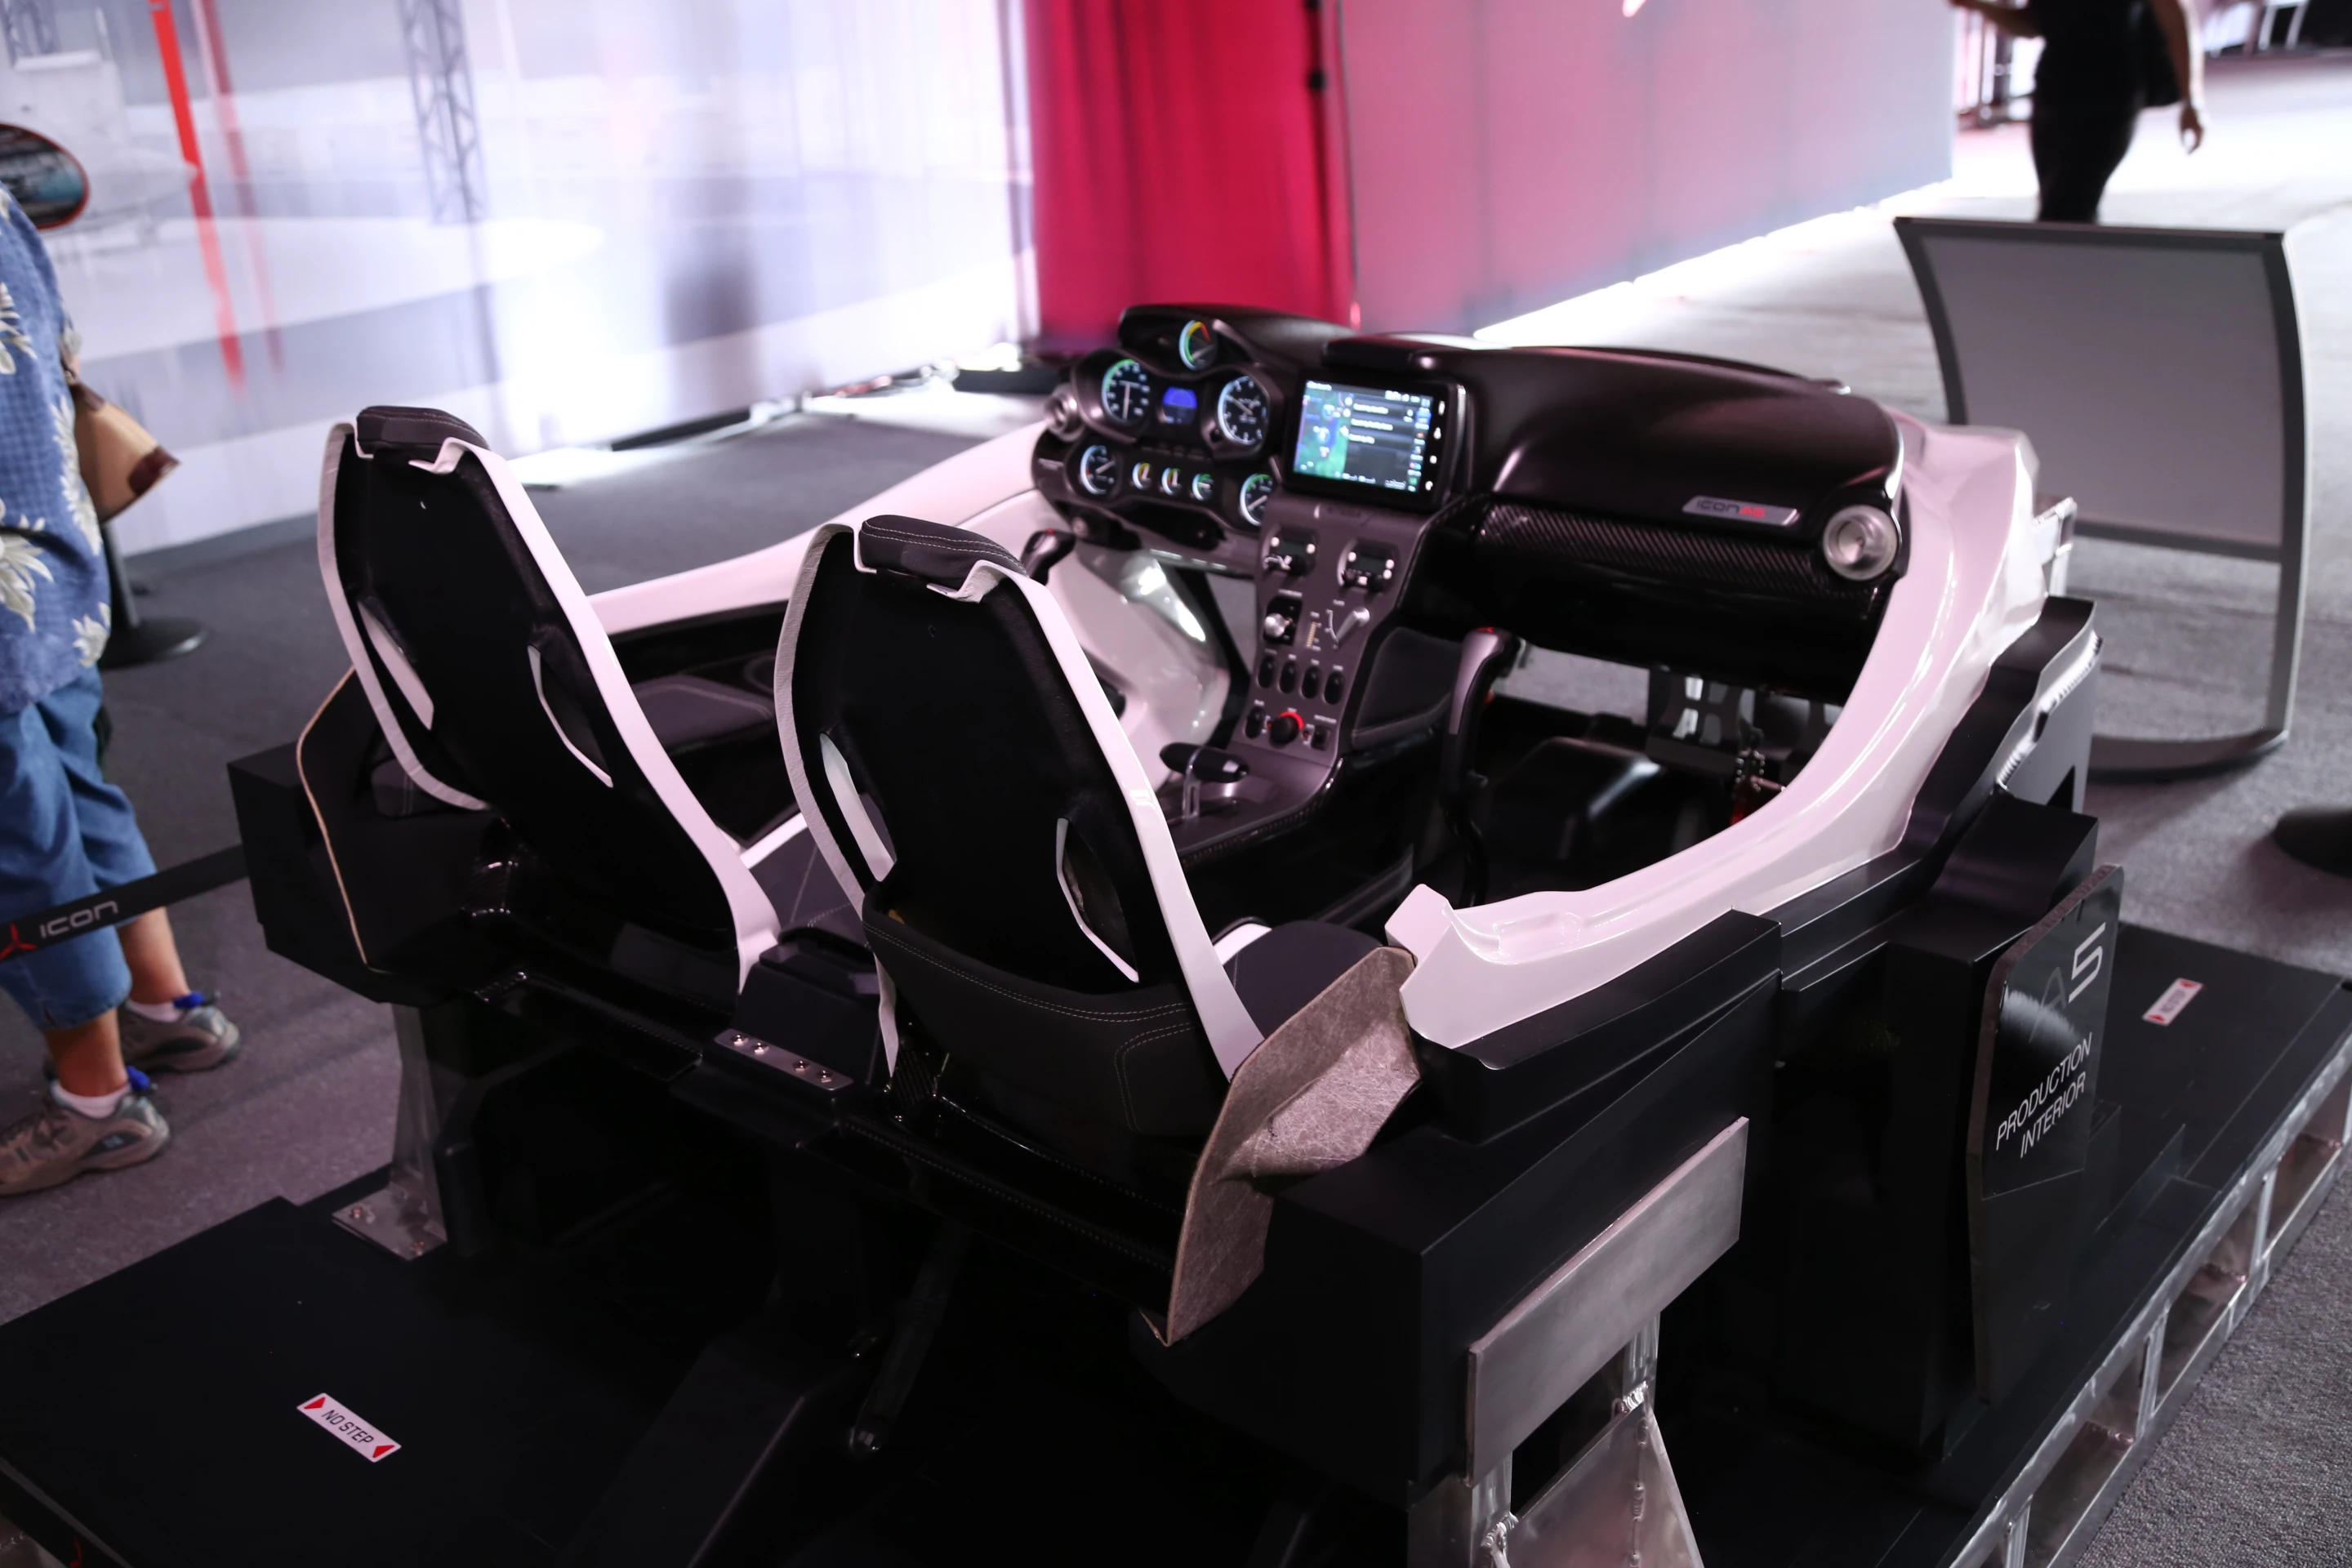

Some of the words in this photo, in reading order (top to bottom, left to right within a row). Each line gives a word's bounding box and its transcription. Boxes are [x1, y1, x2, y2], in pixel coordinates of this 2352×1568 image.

[1995, 1031, 2093, 1152] PRODUCTION
[2020, 1071, 2087, 1159] INTERIOR
[321, 1410, 345, 1425] NO
[338, 1421, 375, 1443] STEP
